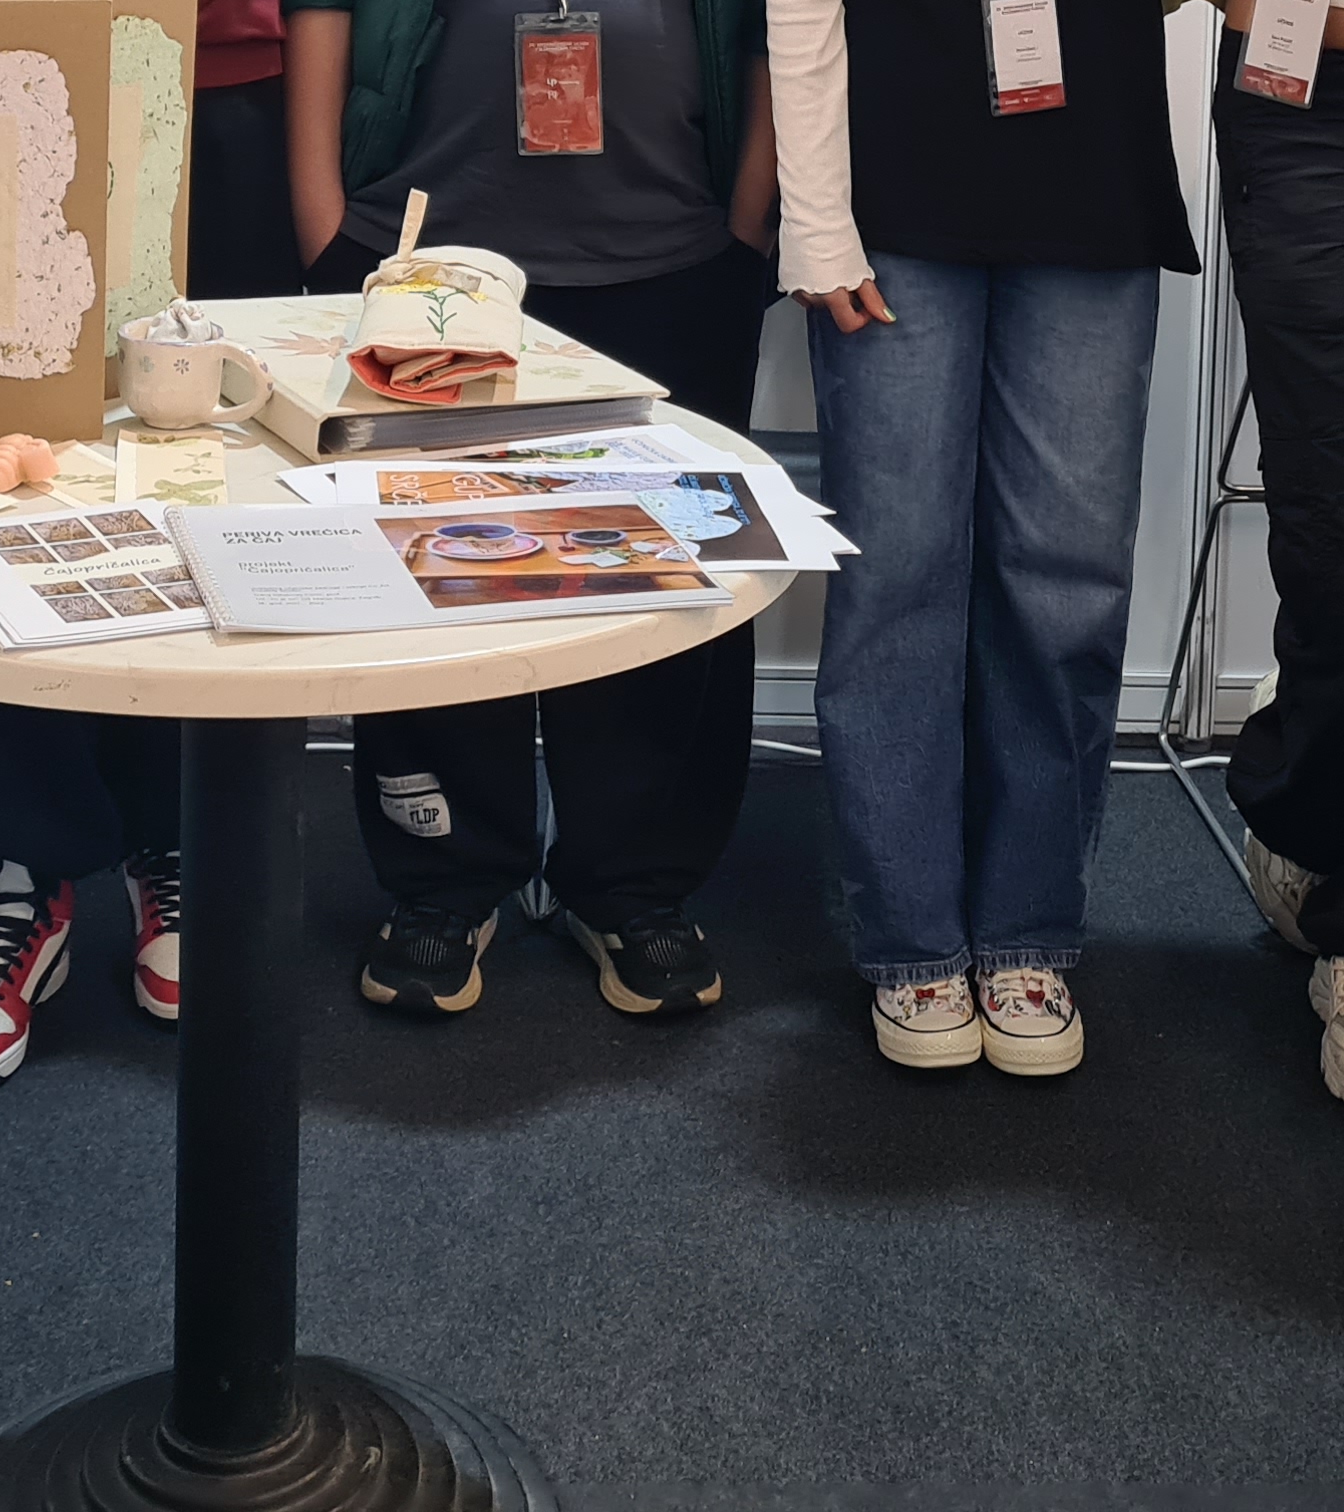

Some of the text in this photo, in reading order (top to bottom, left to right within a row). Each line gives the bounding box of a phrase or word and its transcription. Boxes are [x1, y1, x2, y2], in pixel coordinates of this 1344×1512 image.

[222, 530, 285, 539] PERIVA
[251, 536, 283, 545] ČAJ
[43, 557, 162, 576] Čajopričalica
[238, 561, 293, 569] projekt
